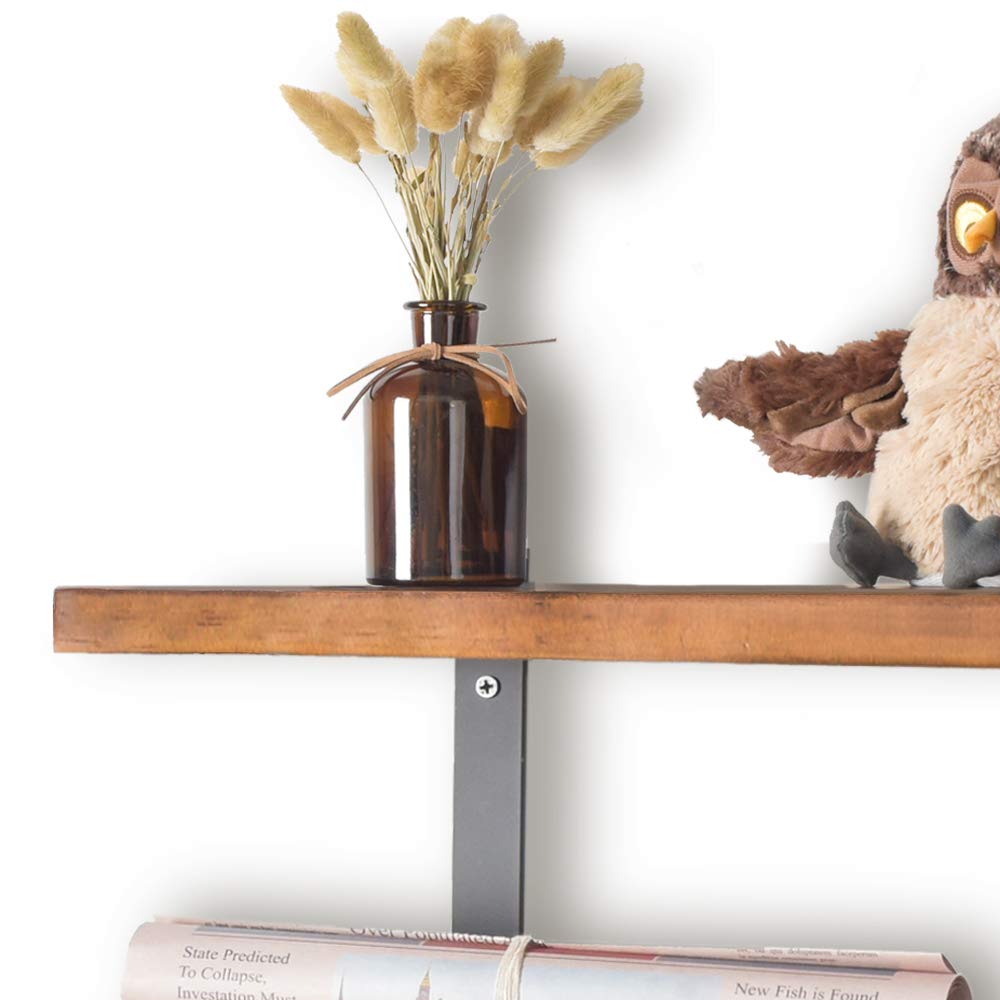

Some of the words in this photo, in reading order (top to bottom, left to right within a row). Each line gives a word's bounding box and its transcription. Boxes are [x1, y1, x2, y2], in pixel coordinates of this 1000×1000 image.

[183, 946, 218, 960] State
[222, 948, 291, 965] Predicted
[179, 965, 197, 979] To
[201, 966, 267, 985] Collapse,
[734, 982, 770, 996] New
[776, 985, 807, 1000] Fish
[812, 987, 824, 1000] is
